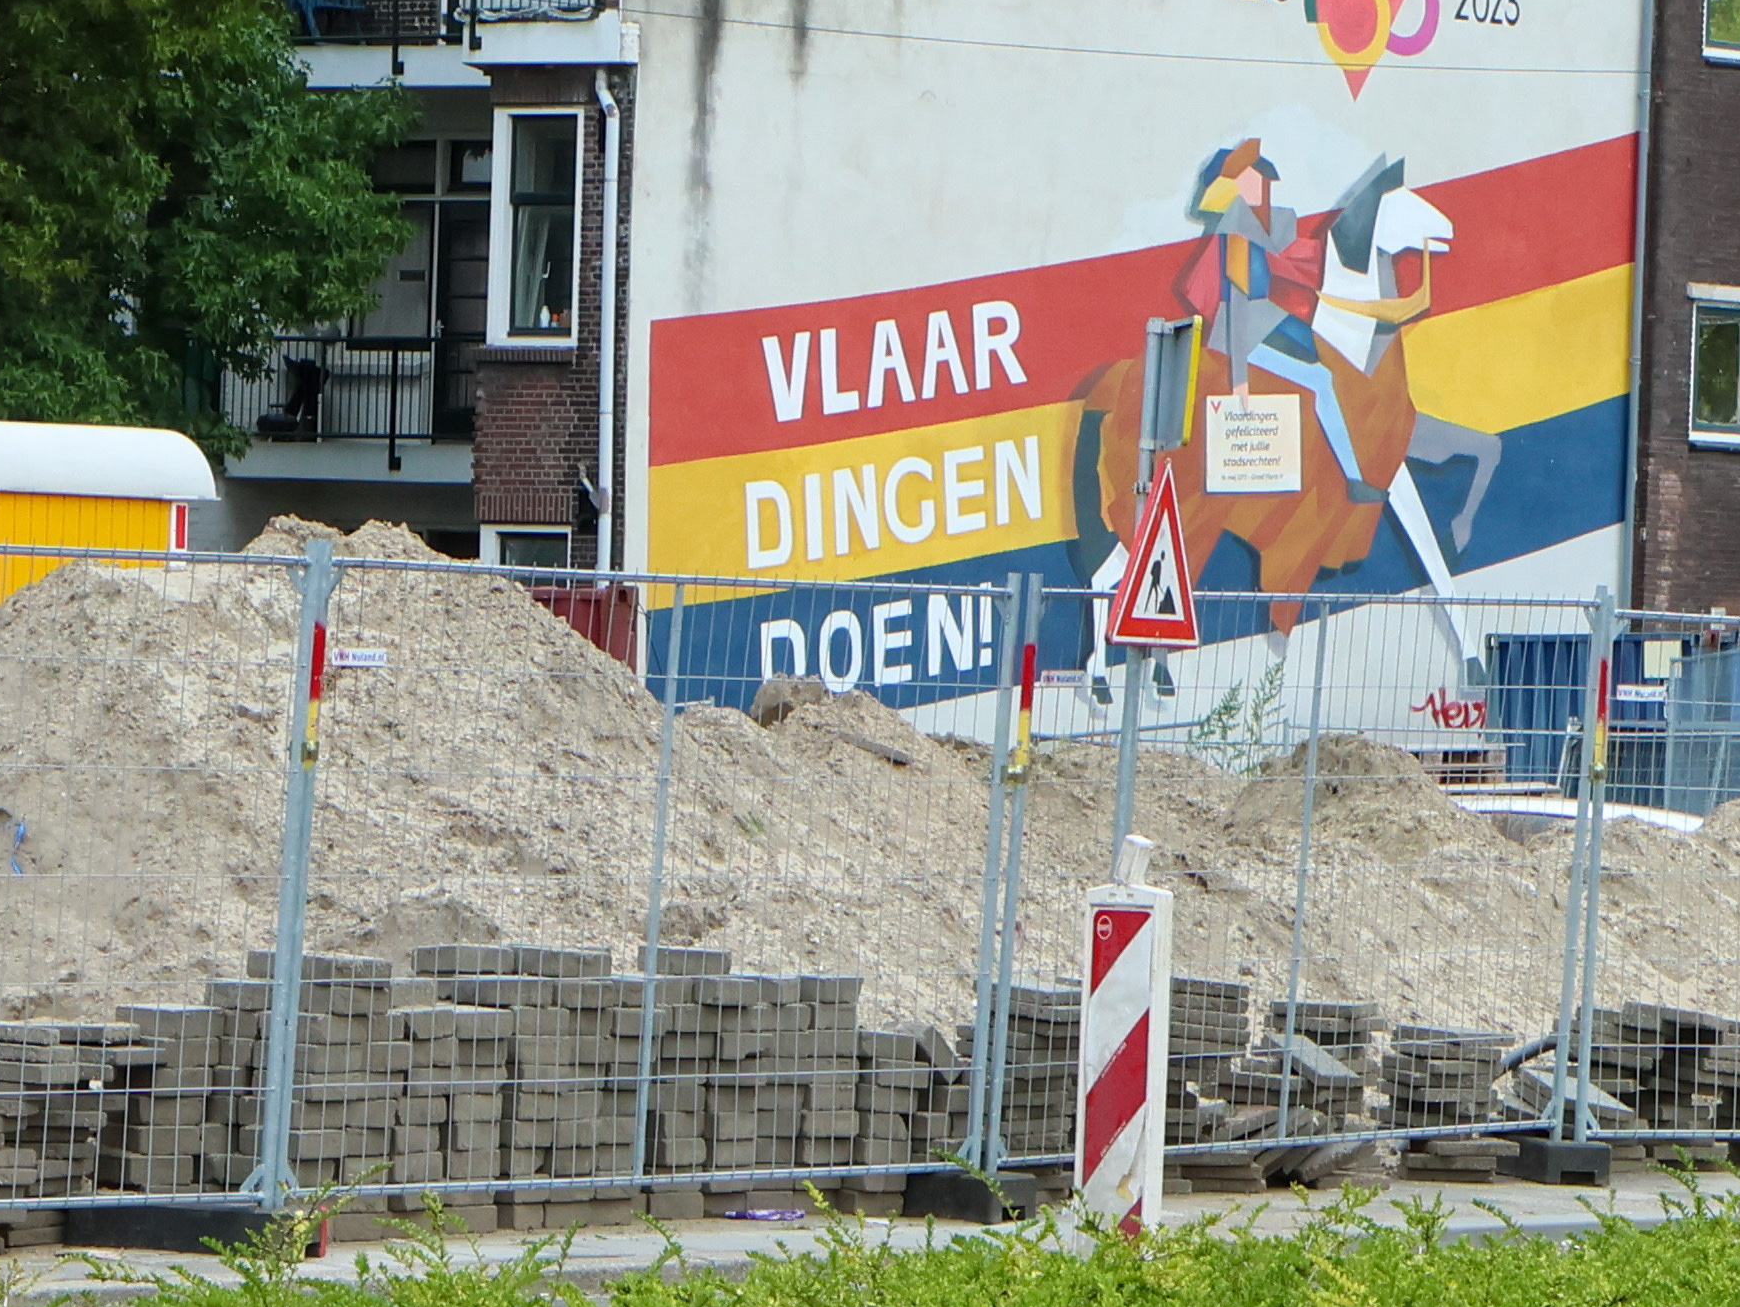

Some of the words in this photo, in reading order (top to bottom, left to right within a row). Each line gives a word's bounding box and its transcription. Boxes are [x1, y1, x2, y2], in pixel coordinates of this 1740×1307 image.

[762, 300, 1027, 422] VLAAR
[745, 435, 1043, 569] DINGEN
[1231, 442, 1248, 452] met
[760, 582, 993, 693] DOEN!
